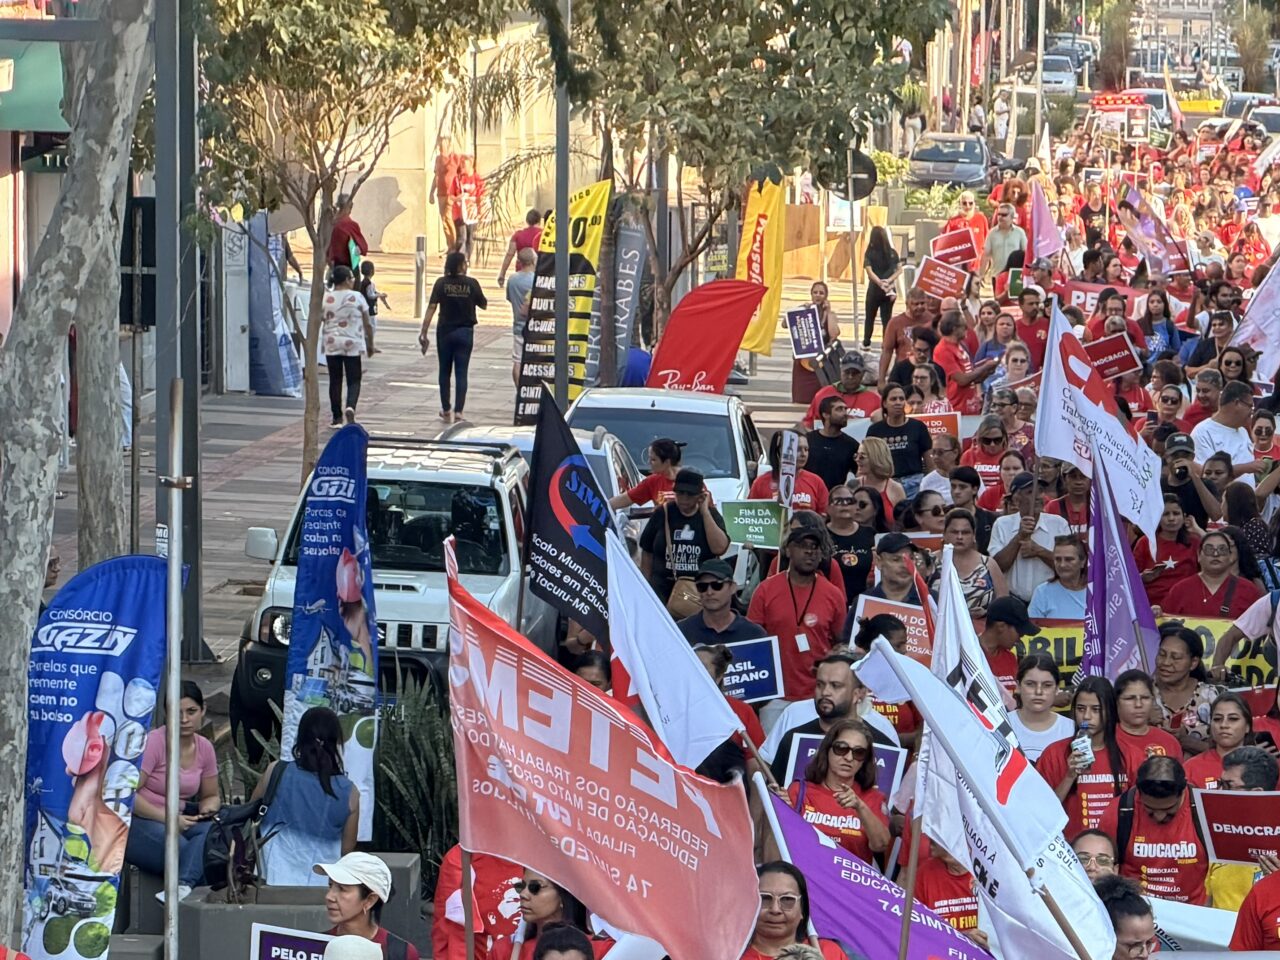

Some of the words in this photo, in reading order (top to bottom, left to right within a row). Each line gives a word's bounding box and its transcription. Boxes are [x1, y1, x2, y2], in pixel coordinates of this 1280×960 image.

[739, 508, 754, 517] FIM
[756, 508, 771, 517] DA
[733, 517, 778, 526] JORNADA
[910, 616, 925, 626] DO
[71, 664, 98, 677] que
[60, 695, 78, 706] no
[1133, 841, 1198, 861] EDUCAÇÃO
[1247, 847, 1278, 857] FETEMS
